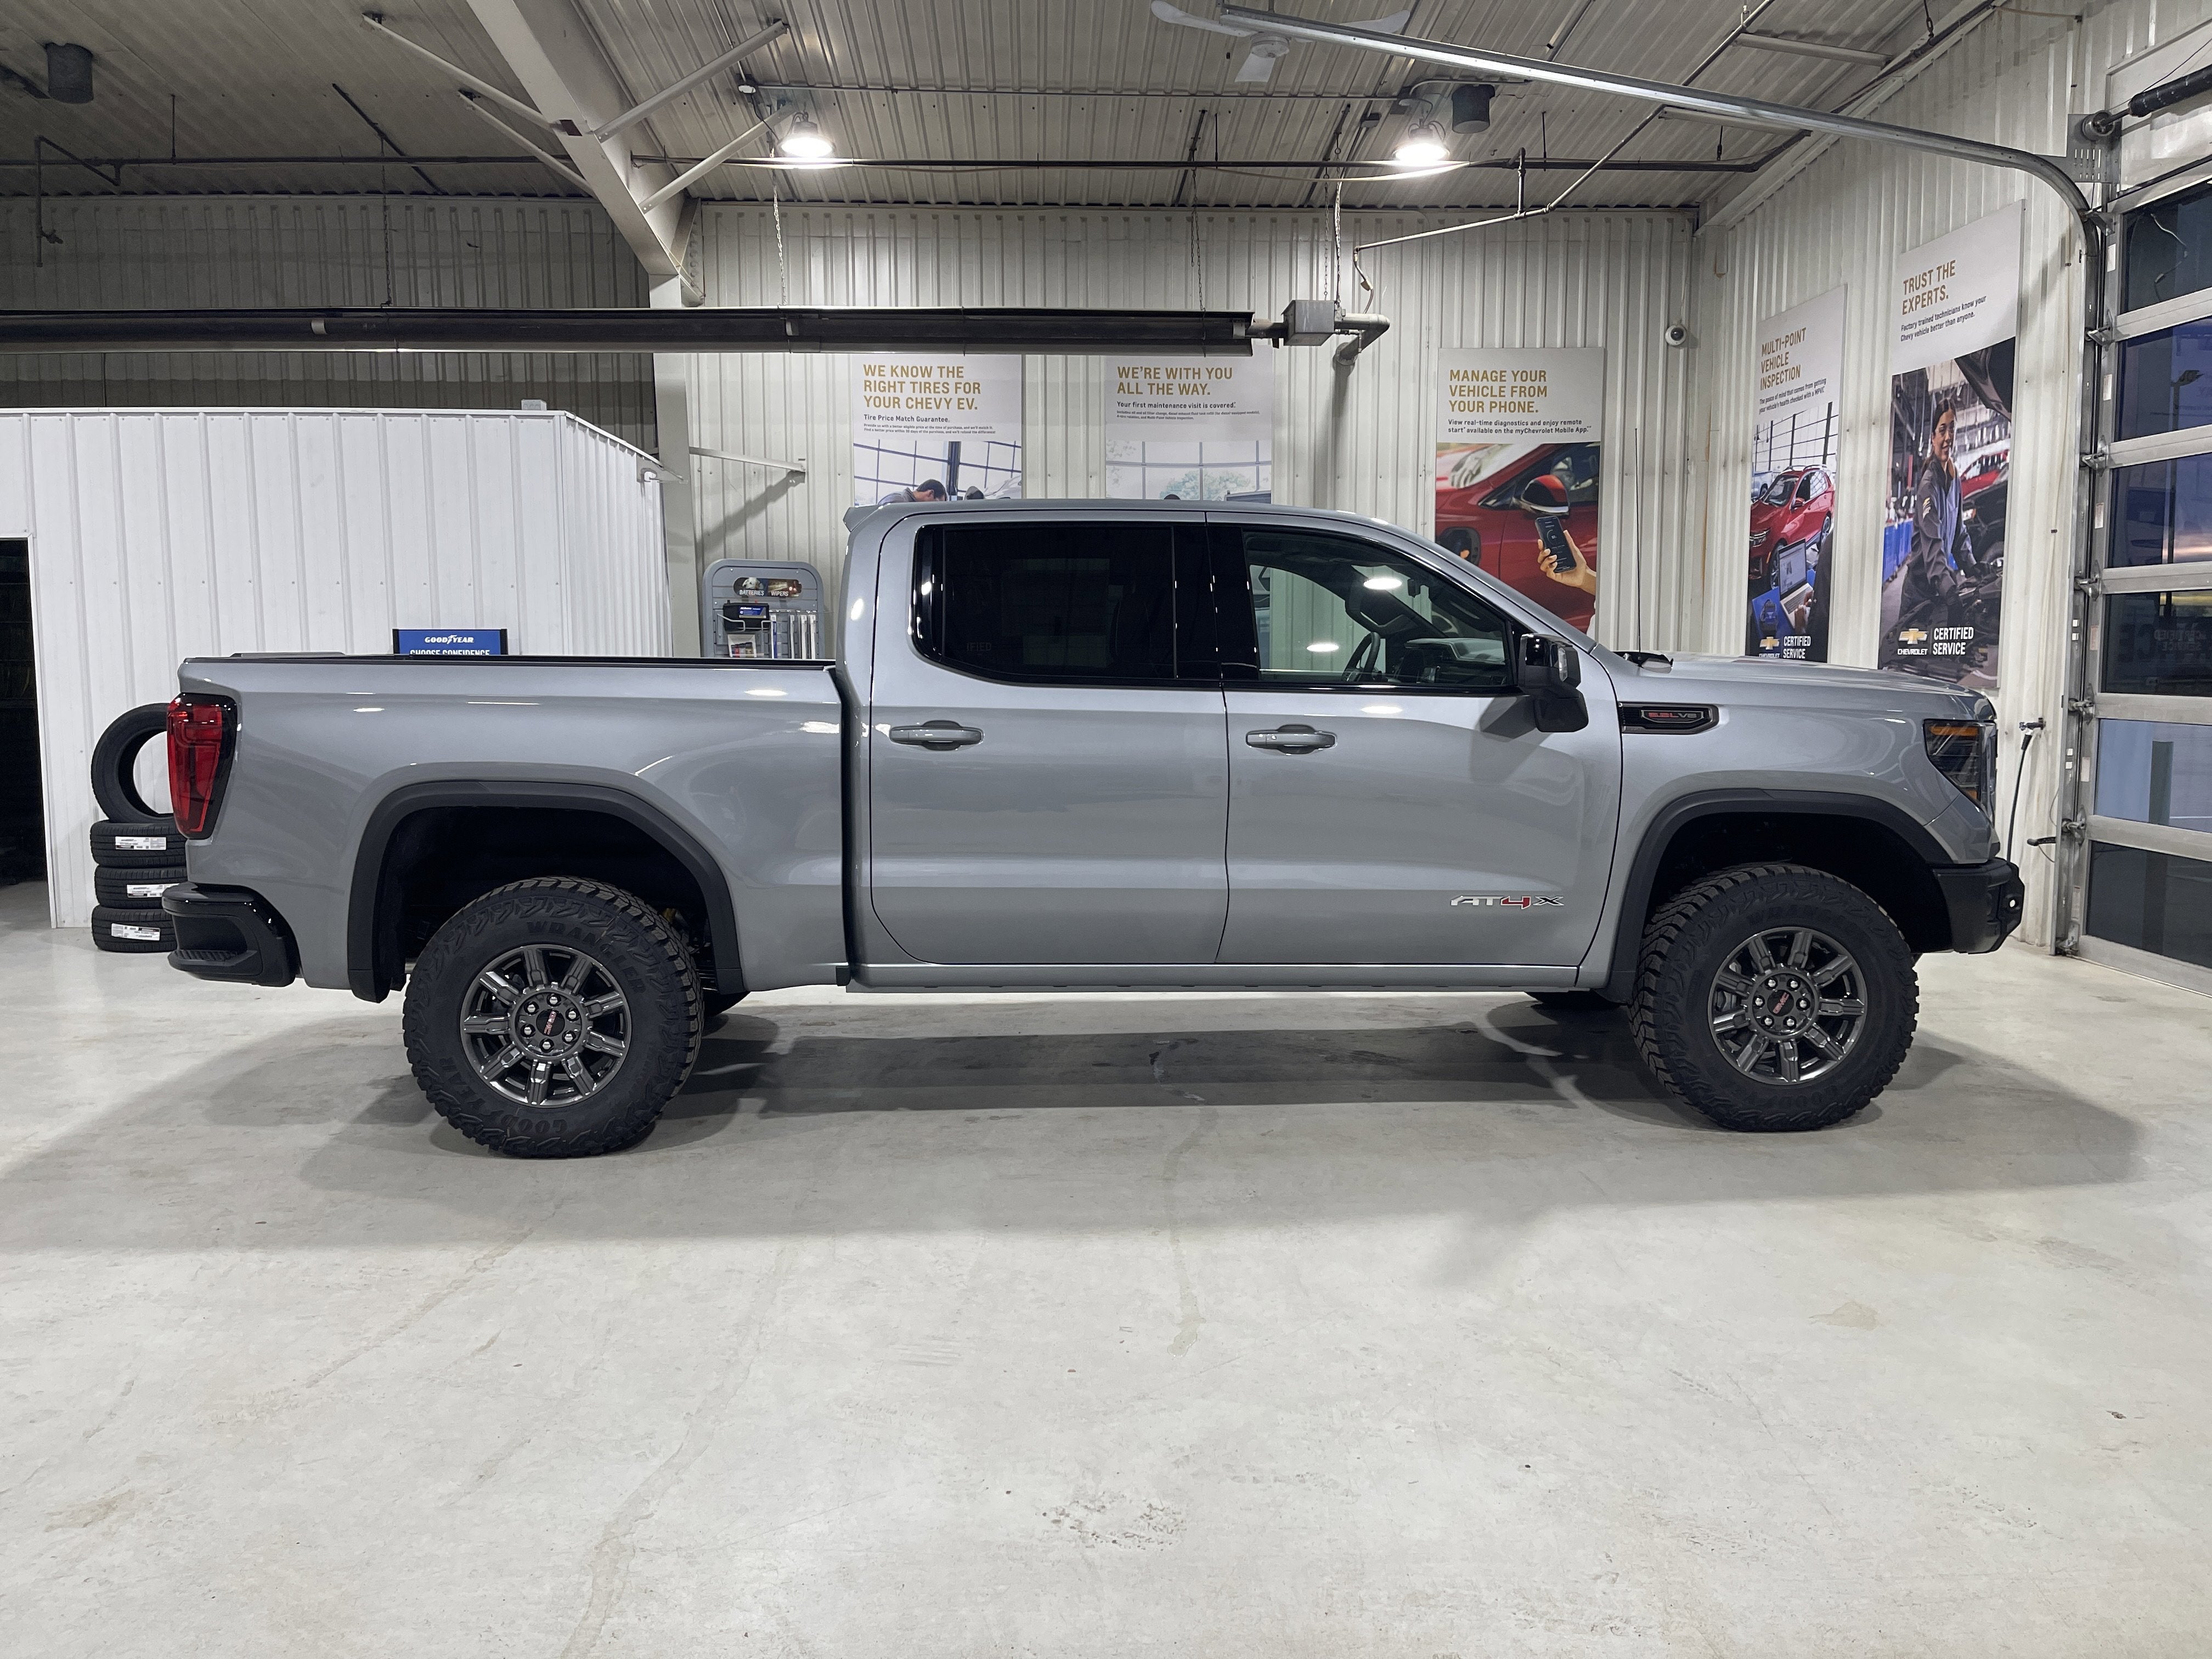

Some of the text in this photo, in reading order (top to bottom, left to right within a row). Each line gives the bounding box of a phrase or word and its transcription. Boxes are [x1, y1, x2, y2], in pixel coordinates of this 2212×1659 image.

[1903, 260, 1956, 295] TRUST THE
[1902, 285, 1949, 315] EXPERTS.
[1901, 296, 1986, 331] Factory trained technicians know your
[1914, 327, 1929, 337] vehicle
[1930, 323, 1944, 332] better
[1945, 318, 1955, 326] than
[1762, 328, 1806, 357] MULTI-POINT
[1761, 352, 1789, 374] VEHICLE
[864, 364, 964, 378] WE KNOW THE
[1118, 366, 1233, 380] WE'RE WITH YOU
[1450, 369, 1547, 382] MANAGE YOUR
[1760, 365, 1801, 391] INSPECTION
[864, 380, 980, 394] RIGHT TIRES FOR
[1117, 382, 1210, 395] ALL THE WAY.
[1449, 385, 1547, 397] VEHICLE FROM
[864, 396, 978, 410] YOUR CHEVY EV.
[1449, 400, 1538, 413] YOUR PHONE.
[425, 635, 474, 644] GOODYEAR
[1934, 627, 1974, 640] CERTIFIED
[1784, 636, 1811, 646] CERTIFIED
[1783, 648, 1805, 658] SERVICE
[1933, 642, 1966, 655] SERVICE
[1450, 895, 1565, 910] AT4X
[526, 921, 647, 994] WRANGLER
[1773, 992, 1790, 1014] GMC
[544, 1011, 557, 1035] GMC
